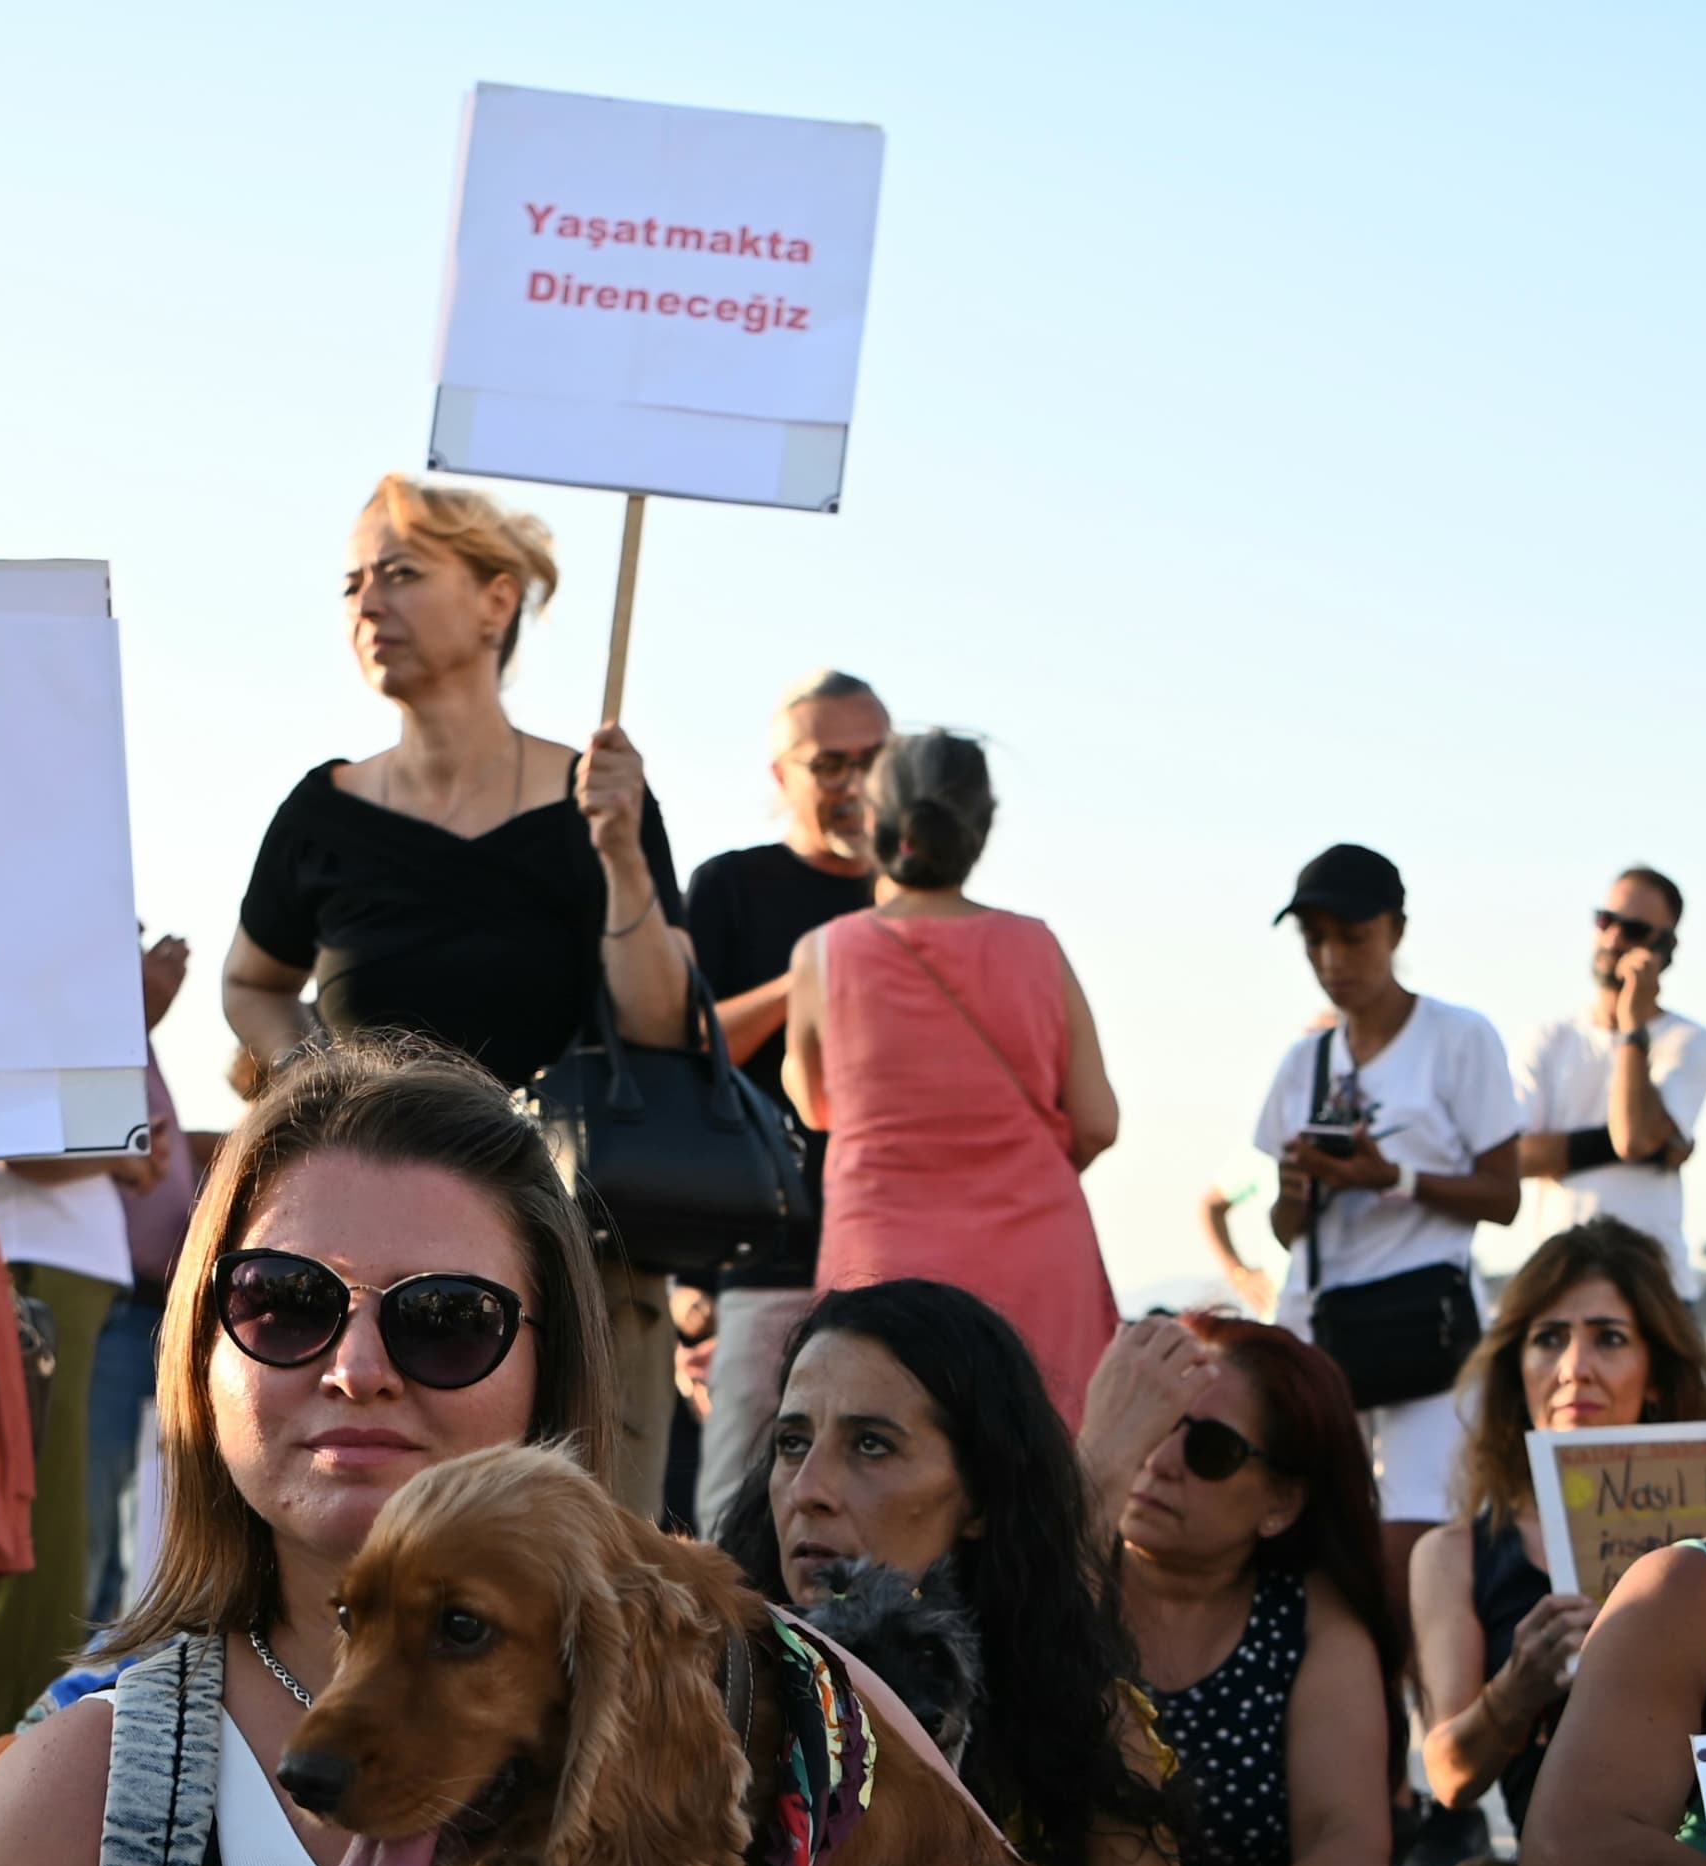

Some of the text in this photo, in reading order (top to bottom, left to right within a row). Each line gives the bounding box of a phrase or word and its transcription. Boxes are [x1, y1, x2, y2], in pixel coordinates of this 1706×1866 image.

[523, 202, 814, 265] Yaşatmakta
[526, 270, 811, 336] Direneceğiz
[1596, 1455, 1687, 1517] Nasıl
